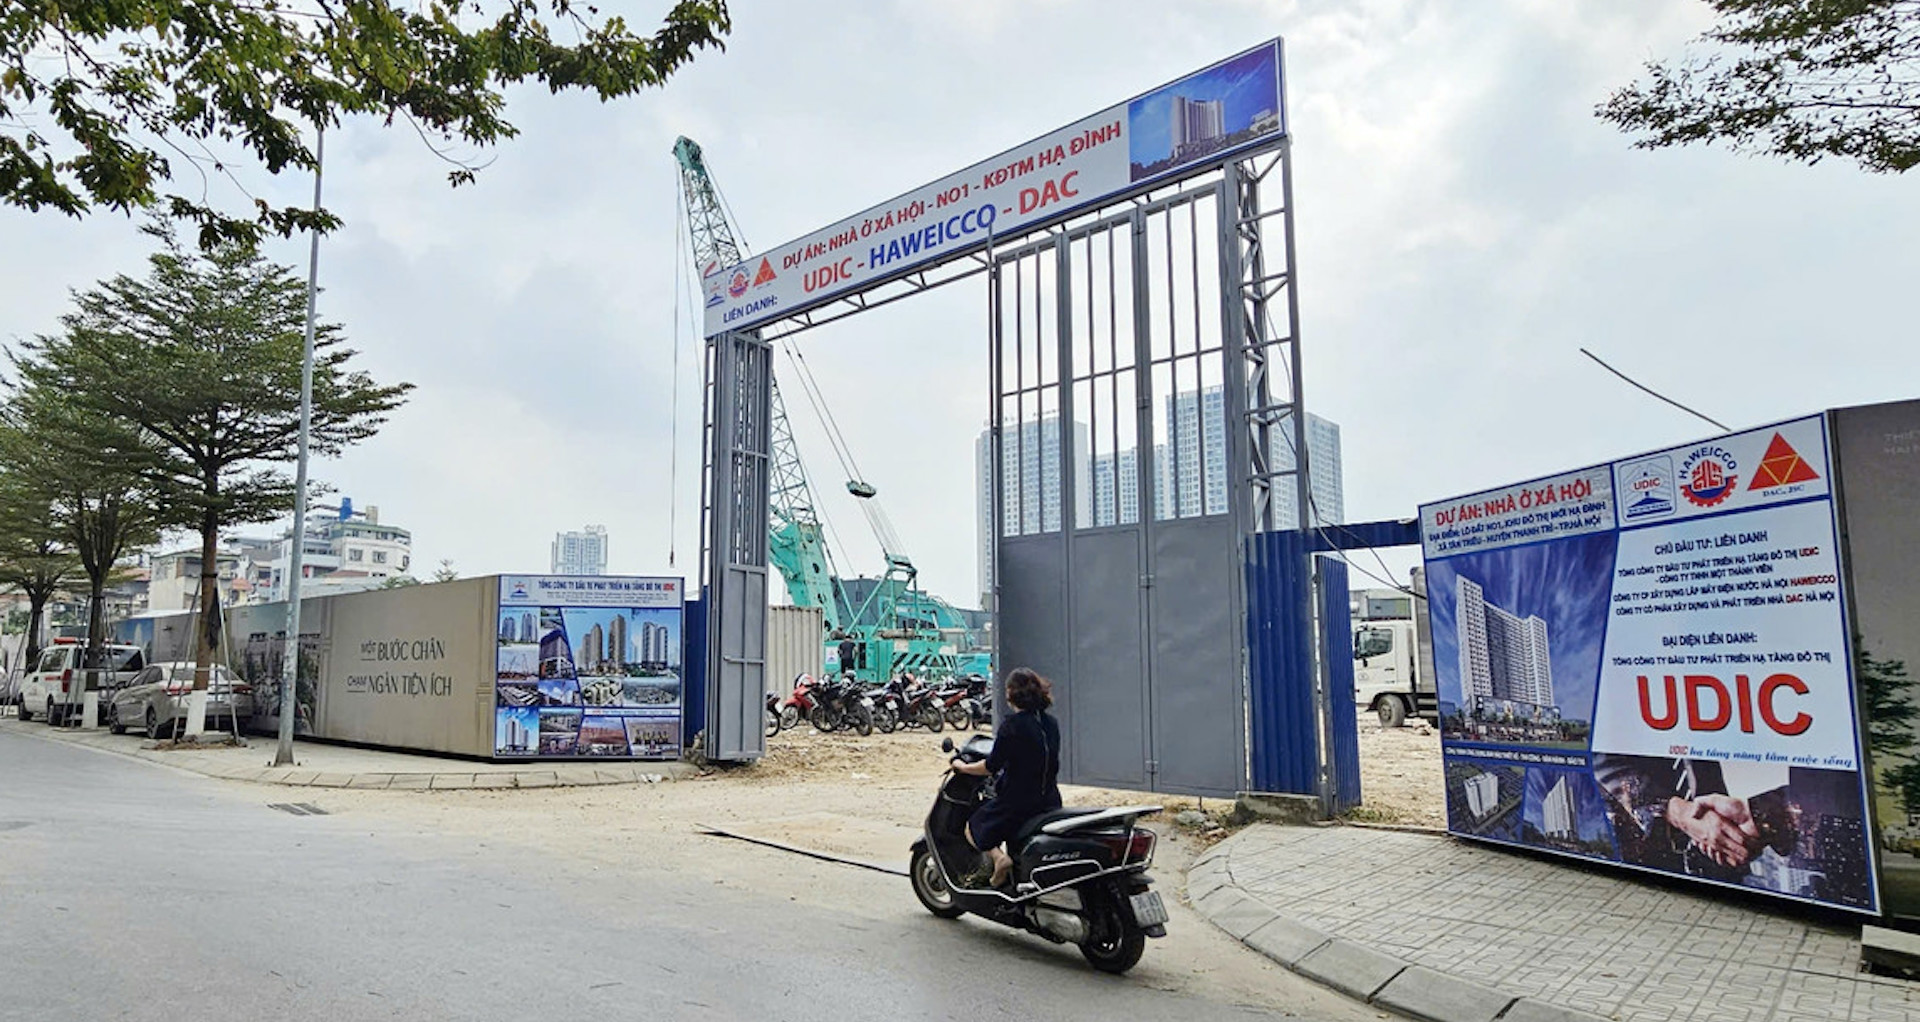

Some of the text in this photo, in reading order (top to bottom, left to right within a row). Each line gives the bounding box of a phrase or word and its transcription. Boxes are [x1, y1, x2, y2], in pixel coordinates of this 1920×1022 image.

[783, 247, 802, 269] DỰ
[804, 242, 826, 261] ÁN:
[829, 226, 858, 251] NHÀ
[861, 219, 872, 238] Ở
[875, 211, 894, 233] XÃ
[897, 200, 924, 223] HỘI
[983, 156, 1034, 190] KĐTM
[1038, 144, 1065, 168] HẠ
[1069, 120, 1121, 155] ĐÌNH
[804, 257, 852, 293] UDIC
[869, 203, 996, 269] HAWEICCO
[1019, 170, 1078, 215] DAC
[723, 295, 778, 323] LIÊN DANH:
[1679, 446, 1737, 479] HAWEICCO
[1634, 477, 1660, 491] UDIC
[1436, 479, 1592, 528] DỰ ÁN: NHÀ Ở XÃ HỘI
[1654, 530, 1768, 555] CHỦ ĐẦU TƯ: LIÊN DANH
[1799, 546, 1819, 557] UDIC
[1786, 593, 1803, 603] DAC
[377, 638, 409, 661] BƯỚC
[411, 637, 445, 661] CHÂN
[1662, 632, 1758, 648] ĐẠI DIỆN LIÊN DANH:
[1612, 656, 1632, 666] TỔNG
[1634, 655, 1655, 665] CÔNG
[1657, 656, 1666, 665] TY
[1667, 654, 1685, 665] ĐẦU
[1686, 654, 1699, 664] TƯ
[1700, 653, 1722, 664] PHÁT
[1752, 654, 1767, 665] HẠ
[1769, 652, 1794, 663] TẦNG
[1797, 651, 1812, 662] ĐÔ
[1814, 651, 1831, 663] THỊ
[401, 672, 427, 699] TIỆN
[430, 672, 452, 697] ÍCH
[1637, 673, 1813, 736] UDIC
